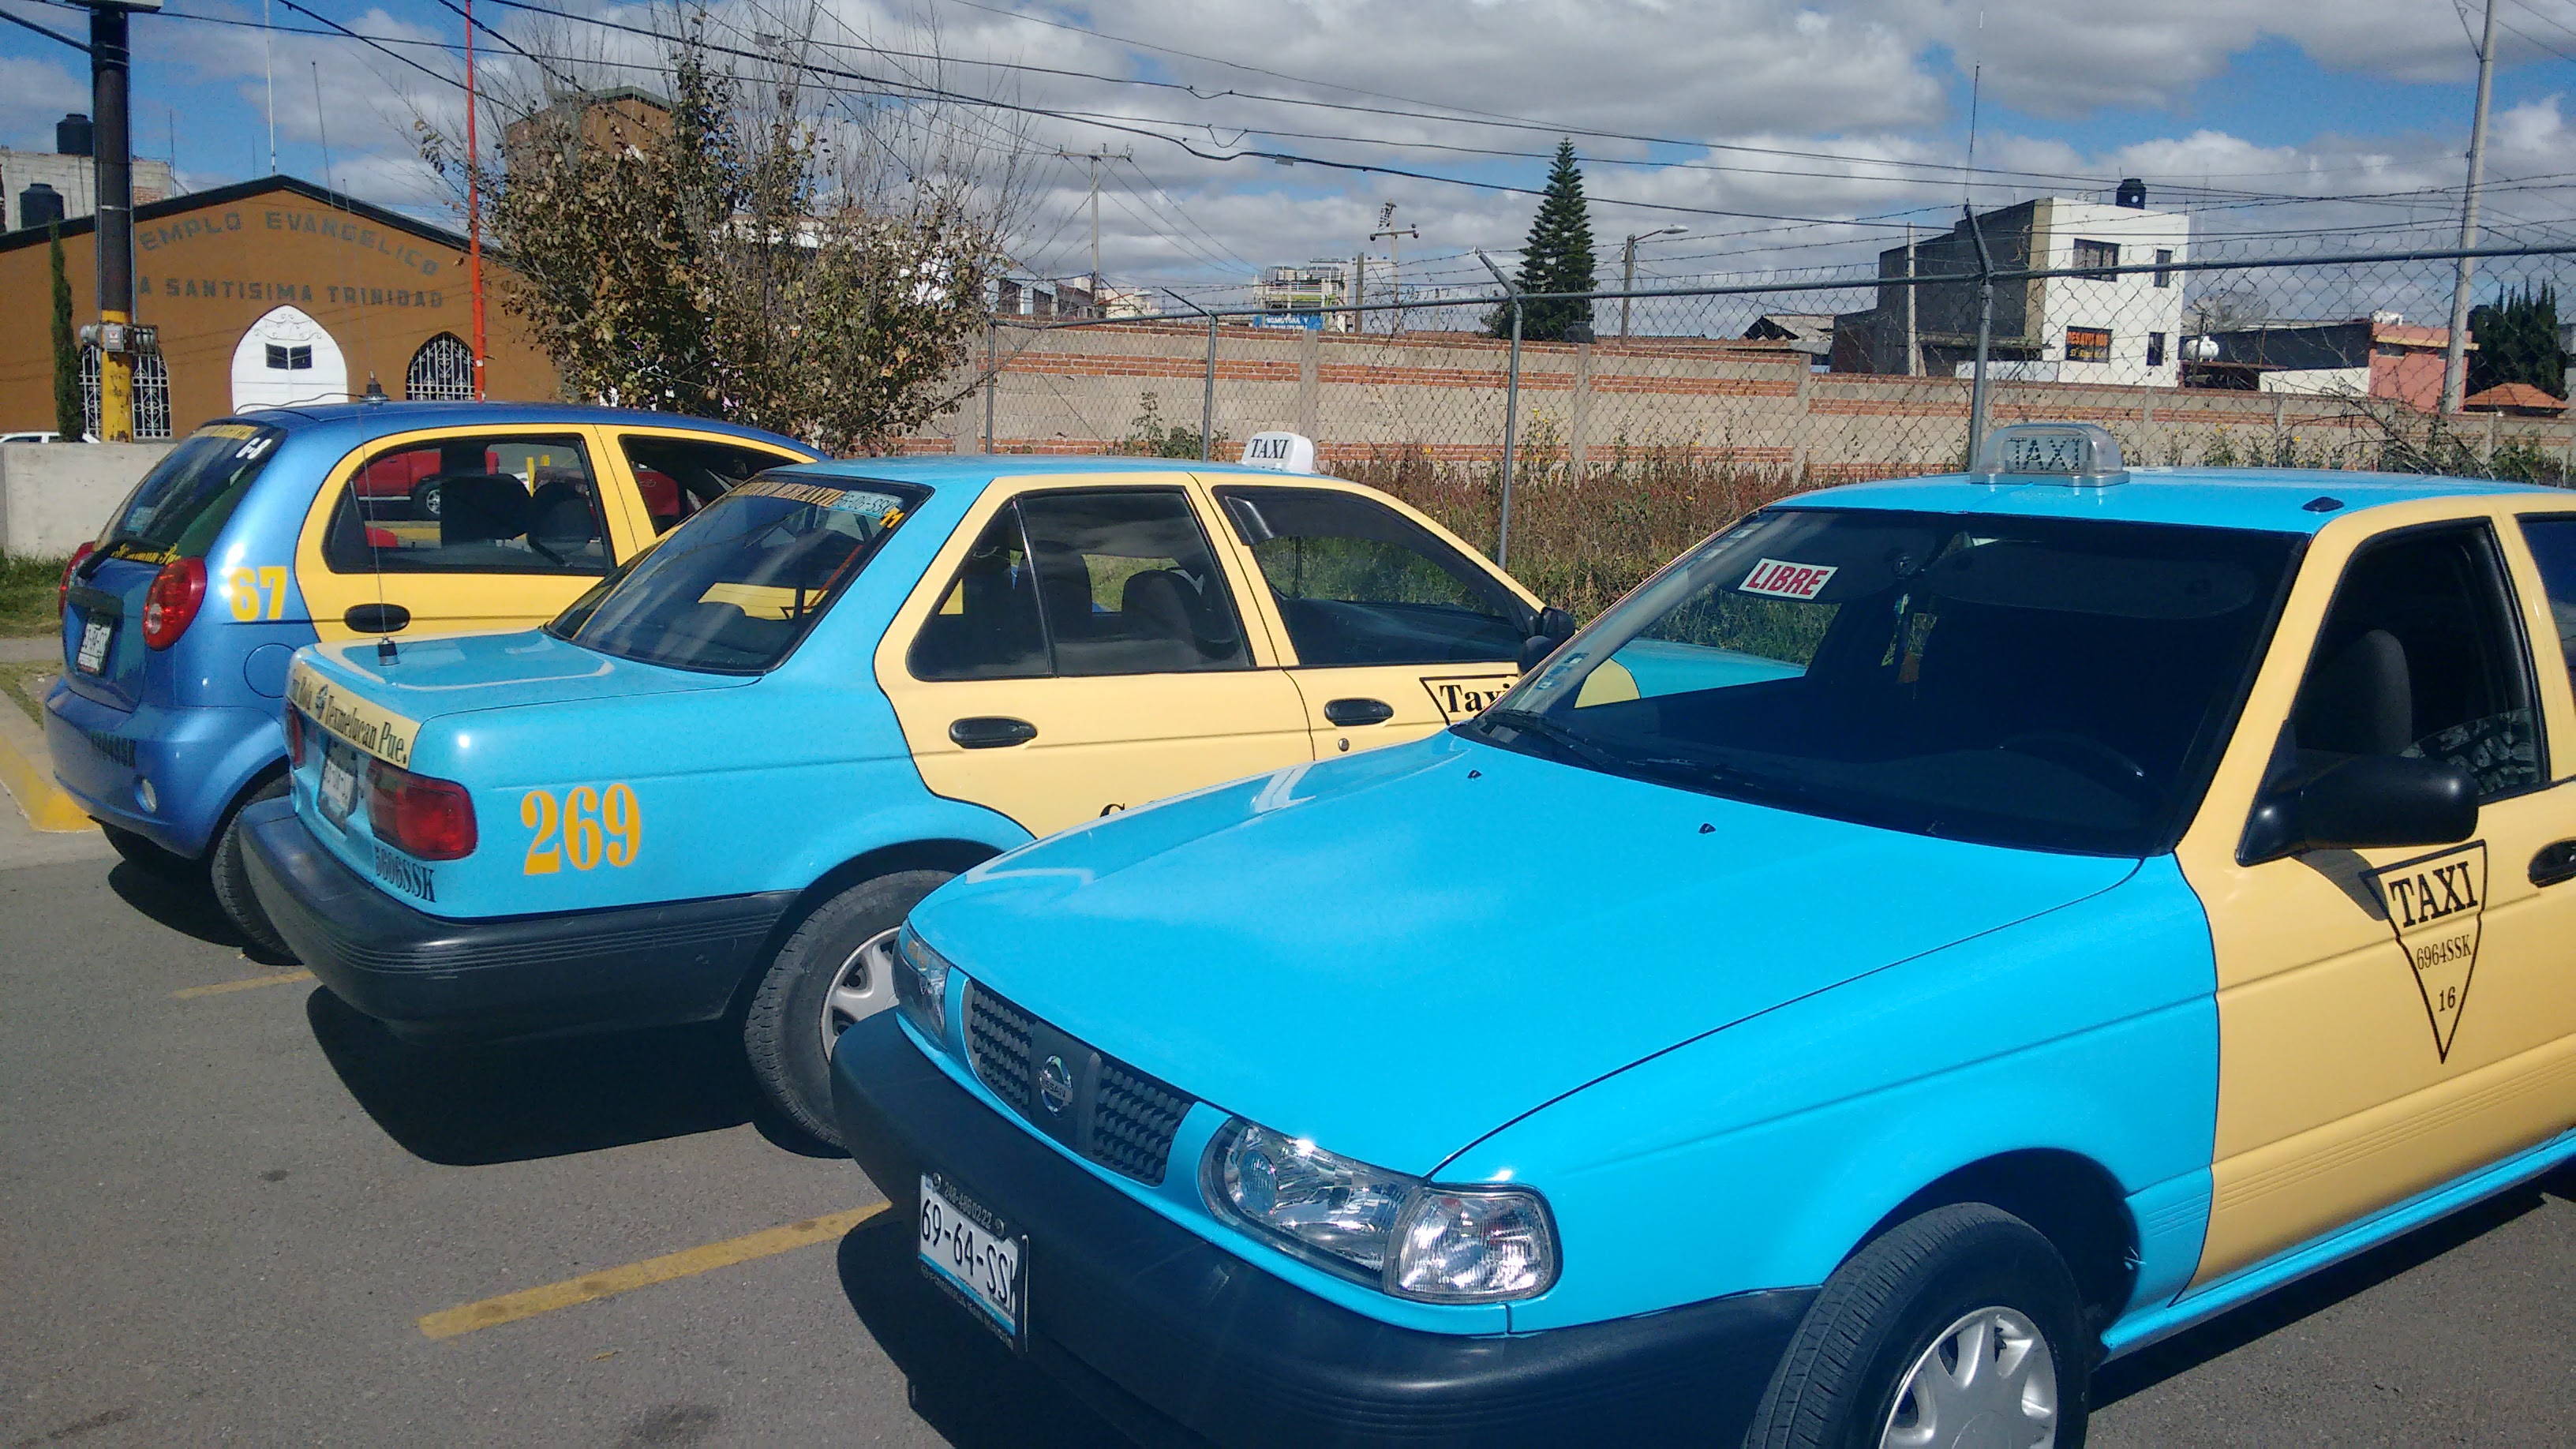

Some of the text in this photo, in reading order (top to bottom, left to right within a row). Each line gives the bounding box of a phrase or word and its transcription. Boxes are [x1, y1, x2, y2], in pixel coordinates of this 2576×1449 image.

[139, 210, 439, 277] EMPLO EVANGELICO
[140, 275, 444, 309] A SANTISIMA TRINIDAD
[1250, 438, 1290, 459] TAXI
[2007, 437, 2084, 471] TAXI
[228, 565, 288, 622] 67
[1746, 563, 1830, 596] LIBRE
[377, 721, 407, 765] Pue.
[521, 782, 641, 875] 269
[2388, 860, 2479, 929] TAXI
[2417, 934, 2473, 971] 6964SSK
[2438, 986, 2457, 1013] 16
